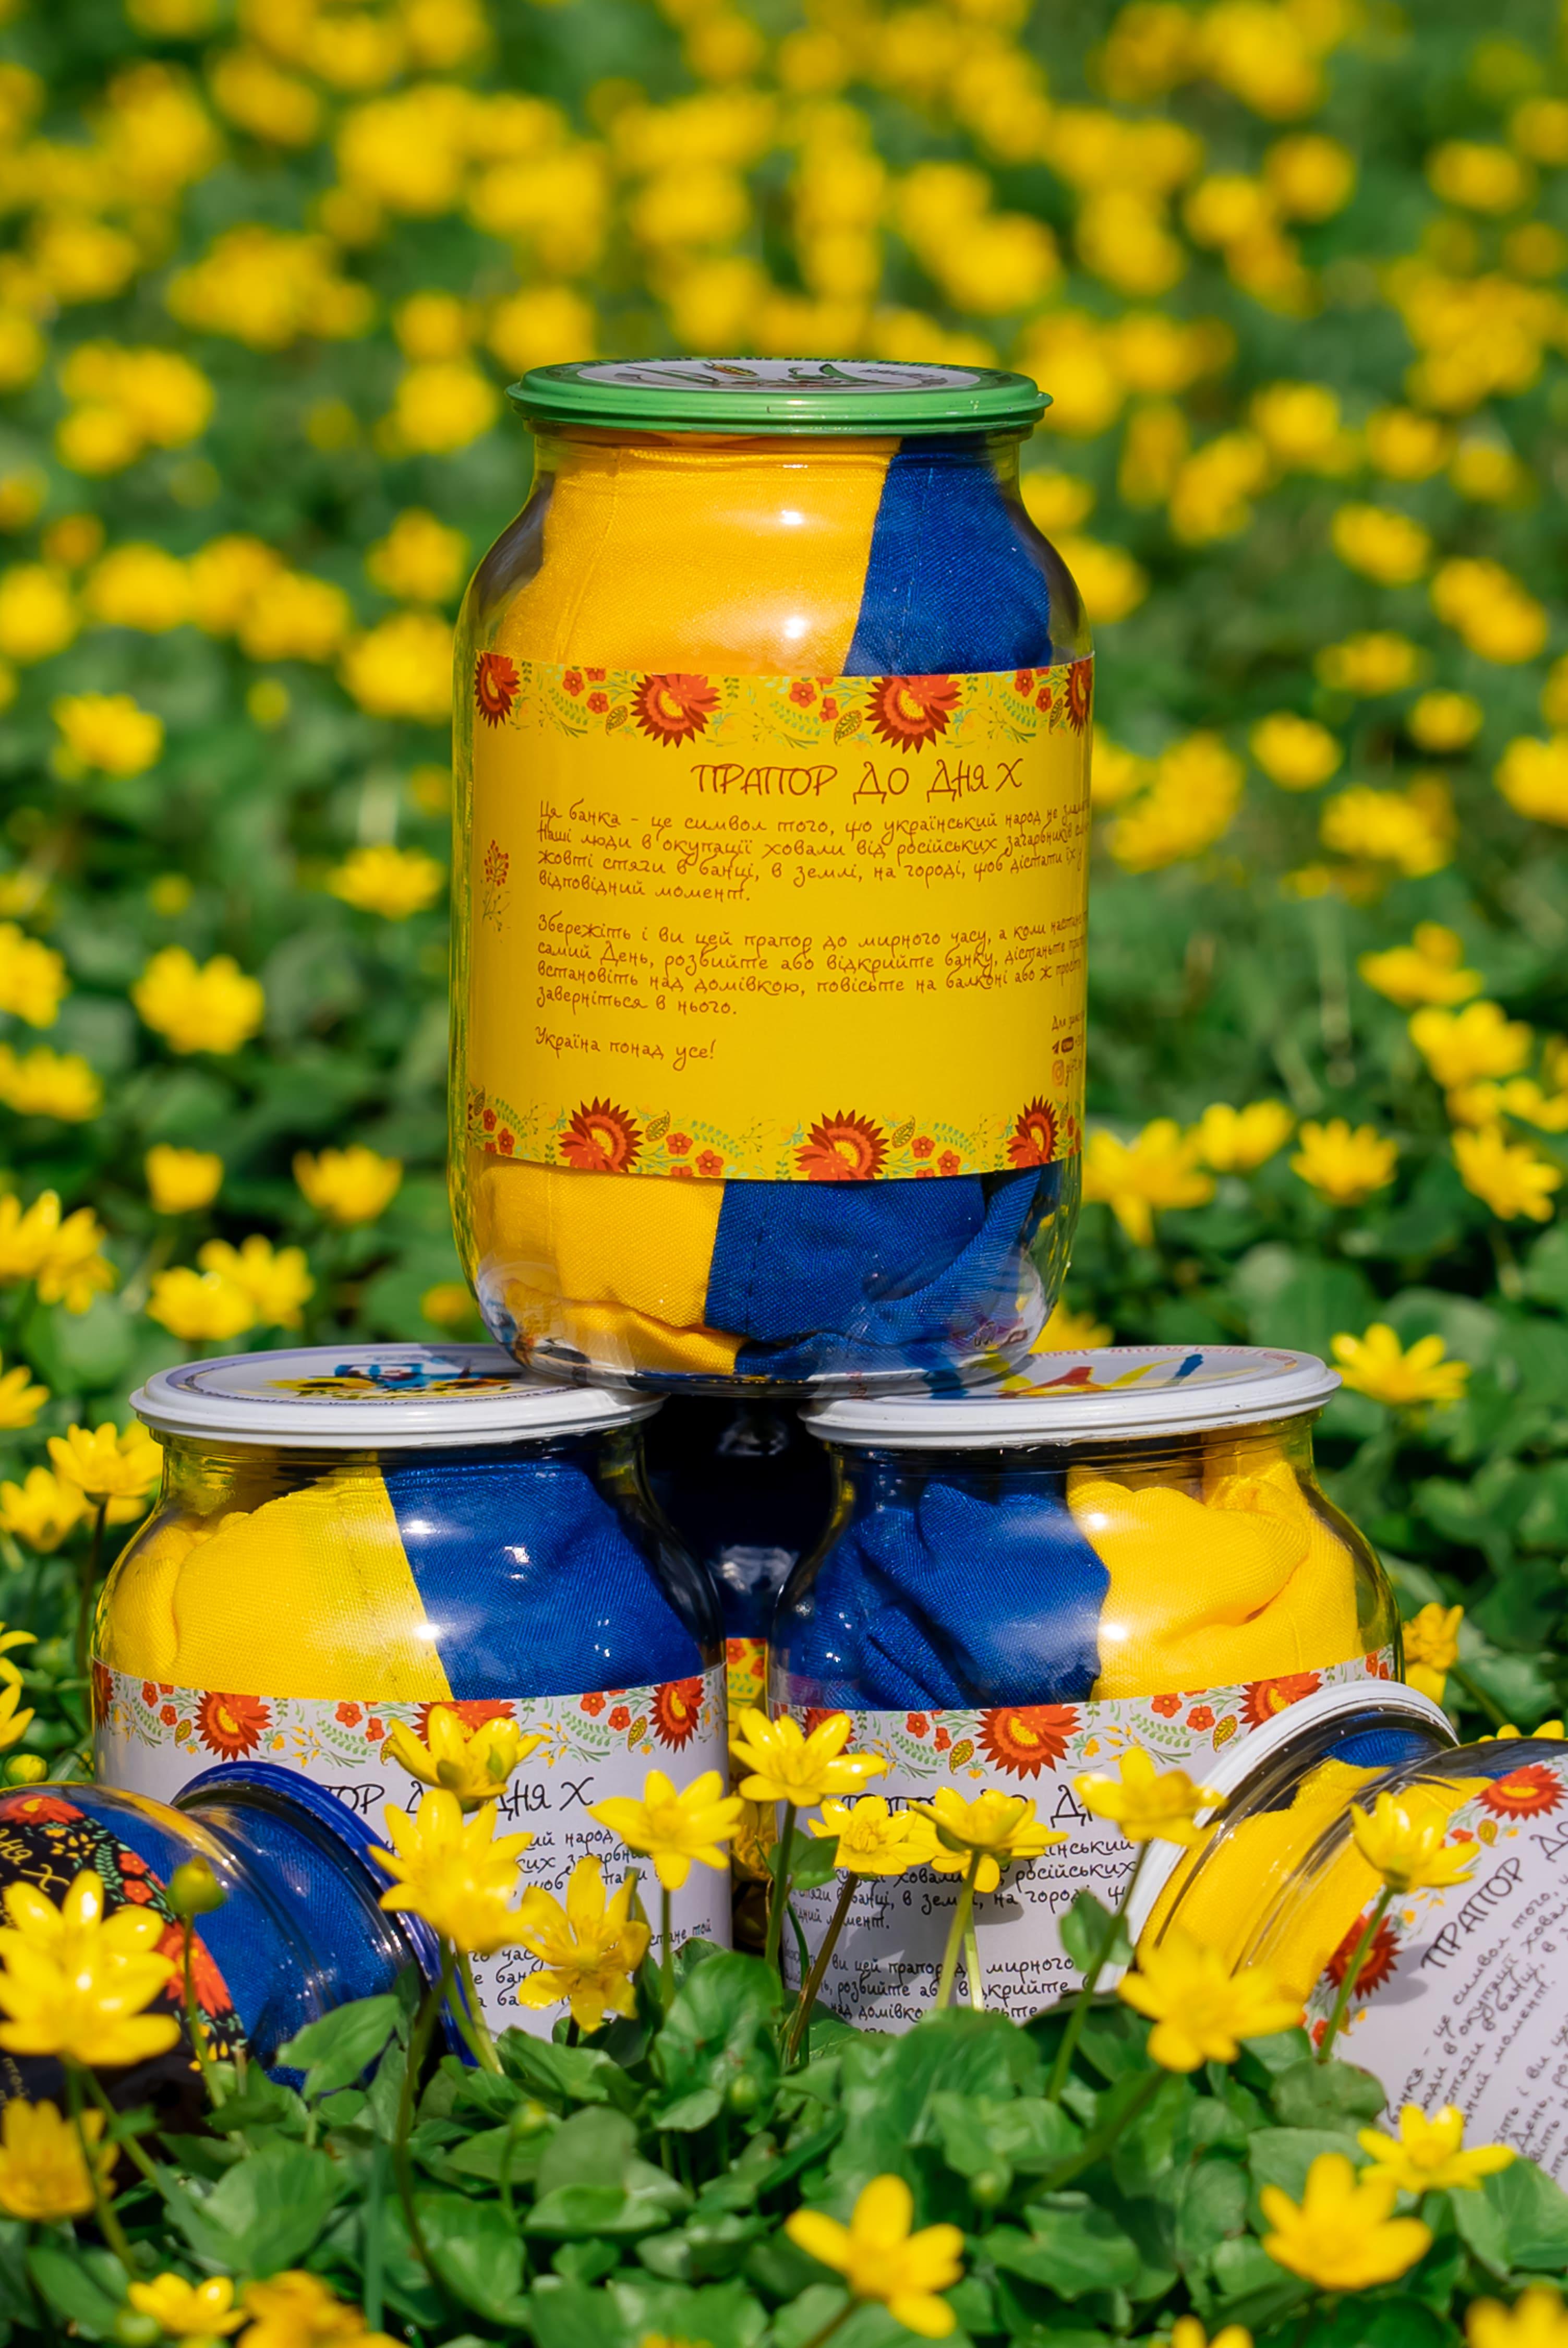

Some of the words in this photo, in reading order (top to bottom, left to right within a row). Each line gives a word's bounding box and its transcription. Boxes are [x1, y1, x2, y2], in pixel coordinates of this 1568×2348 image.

[690, 763, 837, 796] ПРАПОР
[853, 761, 909, 804] ДО
[927, 759, 988, 802] ДНЯ
[540, 800, 562, 831] Ця
[570, 798, 621, 828] банка
[652, 816, 672, 841] це
[685, 815, 767, 831] символ
[777, 820, 835, 835] того,
[845, 821, 872, 841] що
[882, 812, 998, 845] український
[1005, 810, 1041, 835] народ
[1047, 808, 1058, 821] не
[537, 819, 571, 843] Наші
[581, 835, 632, 850] люди
[642, 833, 652, 849] в
[663, 839, 752, 867] окупації
[761, 839, 846, 859] ховали
[857, 838, 886, 859] від
[897, 836, 998, 867] російських
[538, 849, 593, 868] жовті
[603, 858, 666, 874] стяги
[677, 859, 686, 875] в
[699, 853, 759, 889] банці,
[772, 862, 781, 878] в
[793, 864, 862, 888] землі,
[874, 866, 896, 880] на
[904, 860, 966, 888] городі,
[974, 848, 1008, 882] щоб
[1010, 854, 1062, 873] дістати
[539, 869, 645, 896] відповідний
[655, 887, 750, 903] момент.
[538, 911, 631, 945] Збережіть
[642, 927, 648, 941] і
[659, 926, 684, 943] ви
[696, 931, 732, 953] цей
[744, 935, 812, 959] прапор
[823, 935, 847, 950] до
[859, 931, 940, 957] мирного
[951, 929, 991, 953] часу,
[999, 929, 1007, 940] а
[1014, 924, 1046, 941] коли
[538, 941, 592, 960] самий
[600, 941, 654, 968] День,
[665, 945, 768, 976] розбийте
[781, 947, 814, 971] або
[827, 954, 934, 981] відкрийте
[945, 943, 998, 977] банку,
[1005, 942, 1065, 965] дістаньте
[538, 960, 638, 986] встановіть
[650, 975, 683, 992] над
[694, 976, 805, 997] домівкою,
[817, 979, 904, 992] повісьте
[916, 978, 936, 993] на
[946, 964, 1007, 990] балконі
[1015, 957, 1035, 983] або
[1040, 966, 1052, 981] ж
[536, 985, 648, 1015] заверніться
[656, 995, 666, 1010] в
[678, 1000, 737, 1015] нього.
[535, 1025, 600, 1059] Україна
[610, 1041, 664, 1060] понад
[672, 1039, 716, 1071] усе!
[565, 1829, 613, 1855] народ
[1017, 1862, 1137, 1892] російських
[902, 1890, 912, 1906] в
[994, 1893, 1018, 1908] на
[1420, 1857, 1523, 1970] ПРАПОР
[855, 1958, 881, 1974] цей
[986, 1958, 1074, 1984] мирного
[1433, 2015, 1455, 2039] це
[1453, 1936, 1510, 2005] символ
[1512, 1891, 1559, 1930] того,
[838, 1973, 911, 2003] розбийте
[1494, 1981, 1556, 2064] момент.
